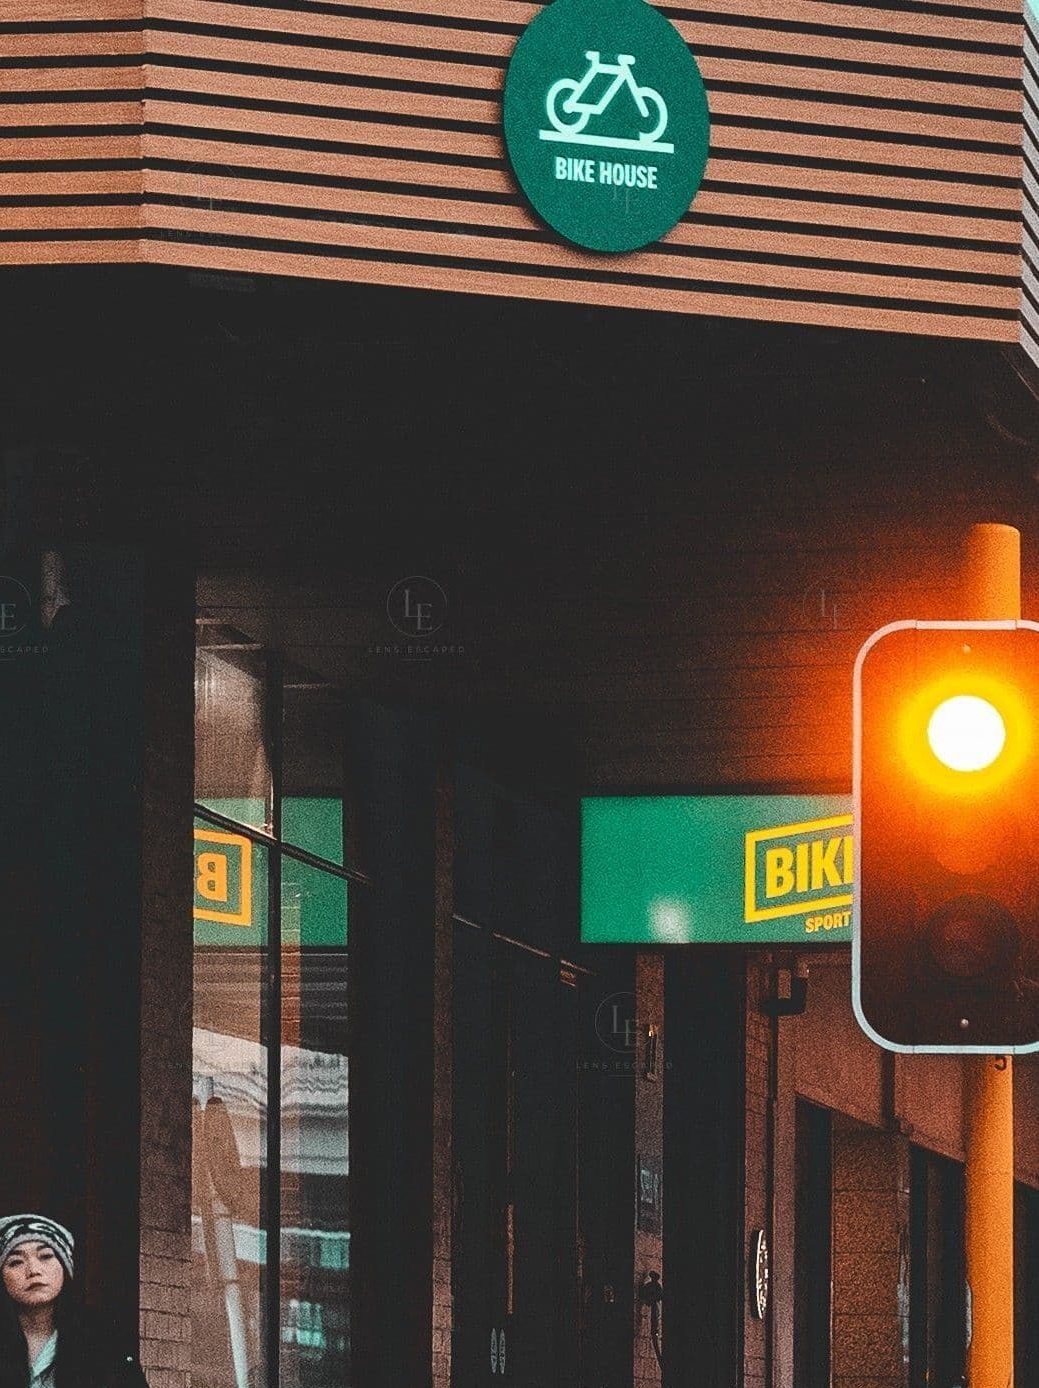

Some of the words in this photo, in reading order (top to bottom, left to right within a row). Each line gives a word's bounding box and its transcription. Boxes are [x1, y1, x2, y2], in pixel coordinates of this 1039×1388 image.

[555, 156, 595, 183] BIKE
[599, 160, 658, 189] HOUSE
[804, 911, 851, 933] SPORT
